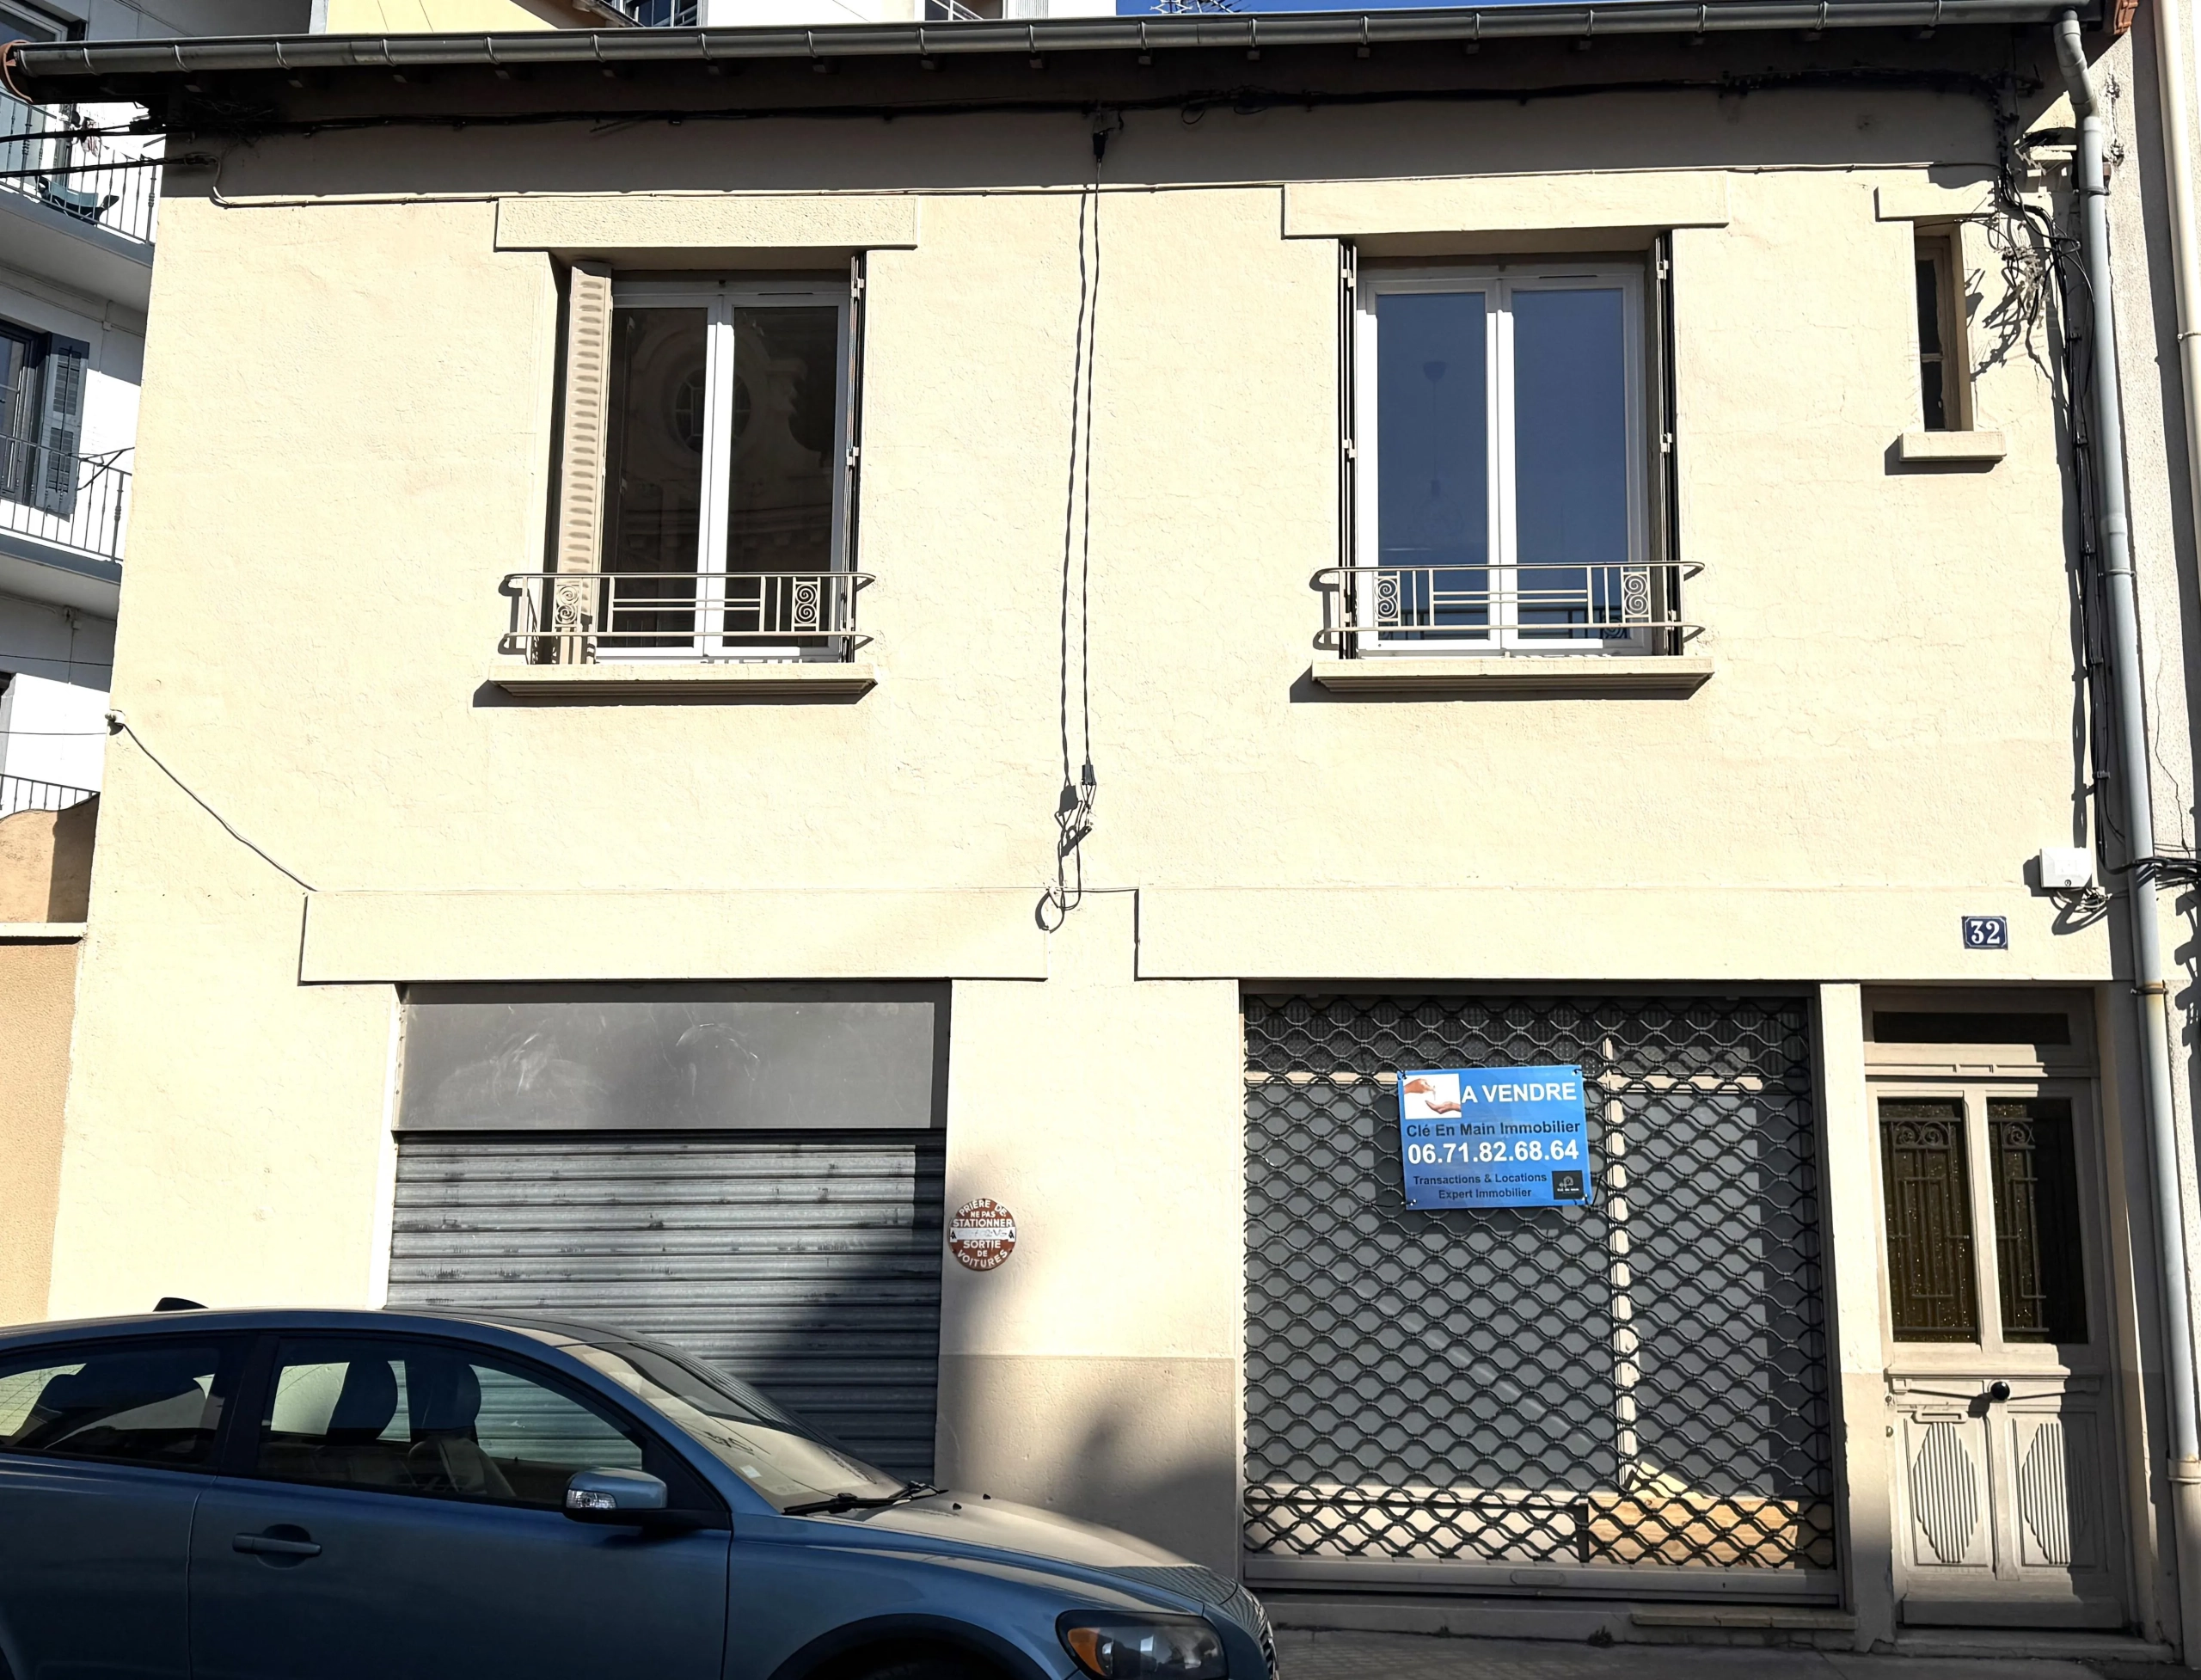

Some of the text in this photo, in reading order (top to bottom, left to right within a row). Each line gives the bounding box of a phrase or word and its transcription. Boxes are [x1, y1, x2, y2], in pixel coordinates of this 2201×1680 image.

[1971, 920, 2001, 945] 32
[1462, 1082, 1577, 1103] A VENDRE
[1407, 1120, 1581, 1137] Clé En Main Immobilier
[1407, 1139, 1579, 1164] 06.71.82.68.64
[1413, 1173, 1548, 1186] Transactions & Locations
[1438, 1187, 1532, 1201] Expert Immobilier
[994, 1204, 1008, 1217] DE
[953, 1218, 1013, 1228] STATIONNER
[963, 1240, 1002, 1249] SORTIE
[957, 1249, 1008, 1268] VOITURES
